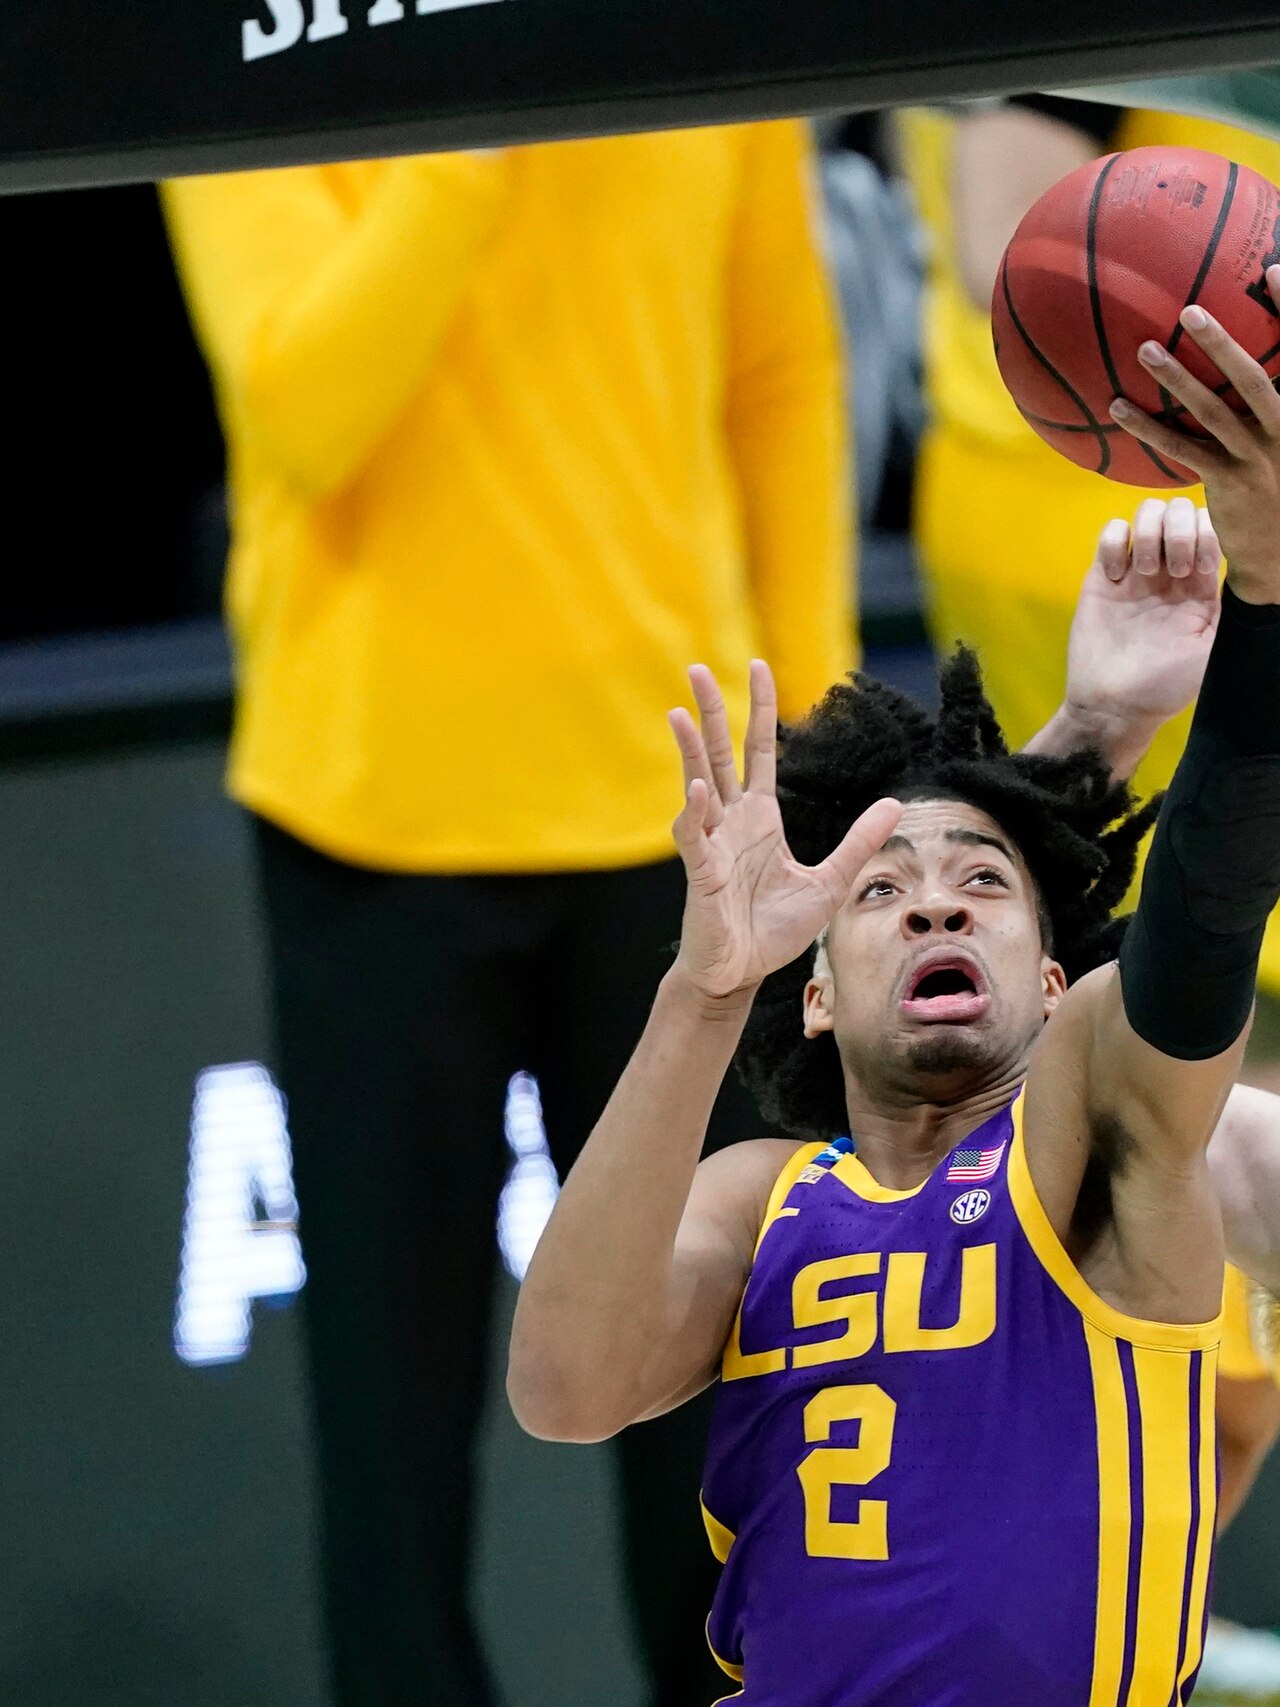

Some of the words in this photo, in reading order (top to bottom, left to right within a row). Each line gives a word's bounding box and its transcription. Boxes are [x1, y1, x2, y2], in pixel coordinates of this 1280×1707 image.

[953, 1191, 985, 1221] SEC
[722, 1243, 997, 1382] LSU
[797, 1383, 897, 1561] 2
